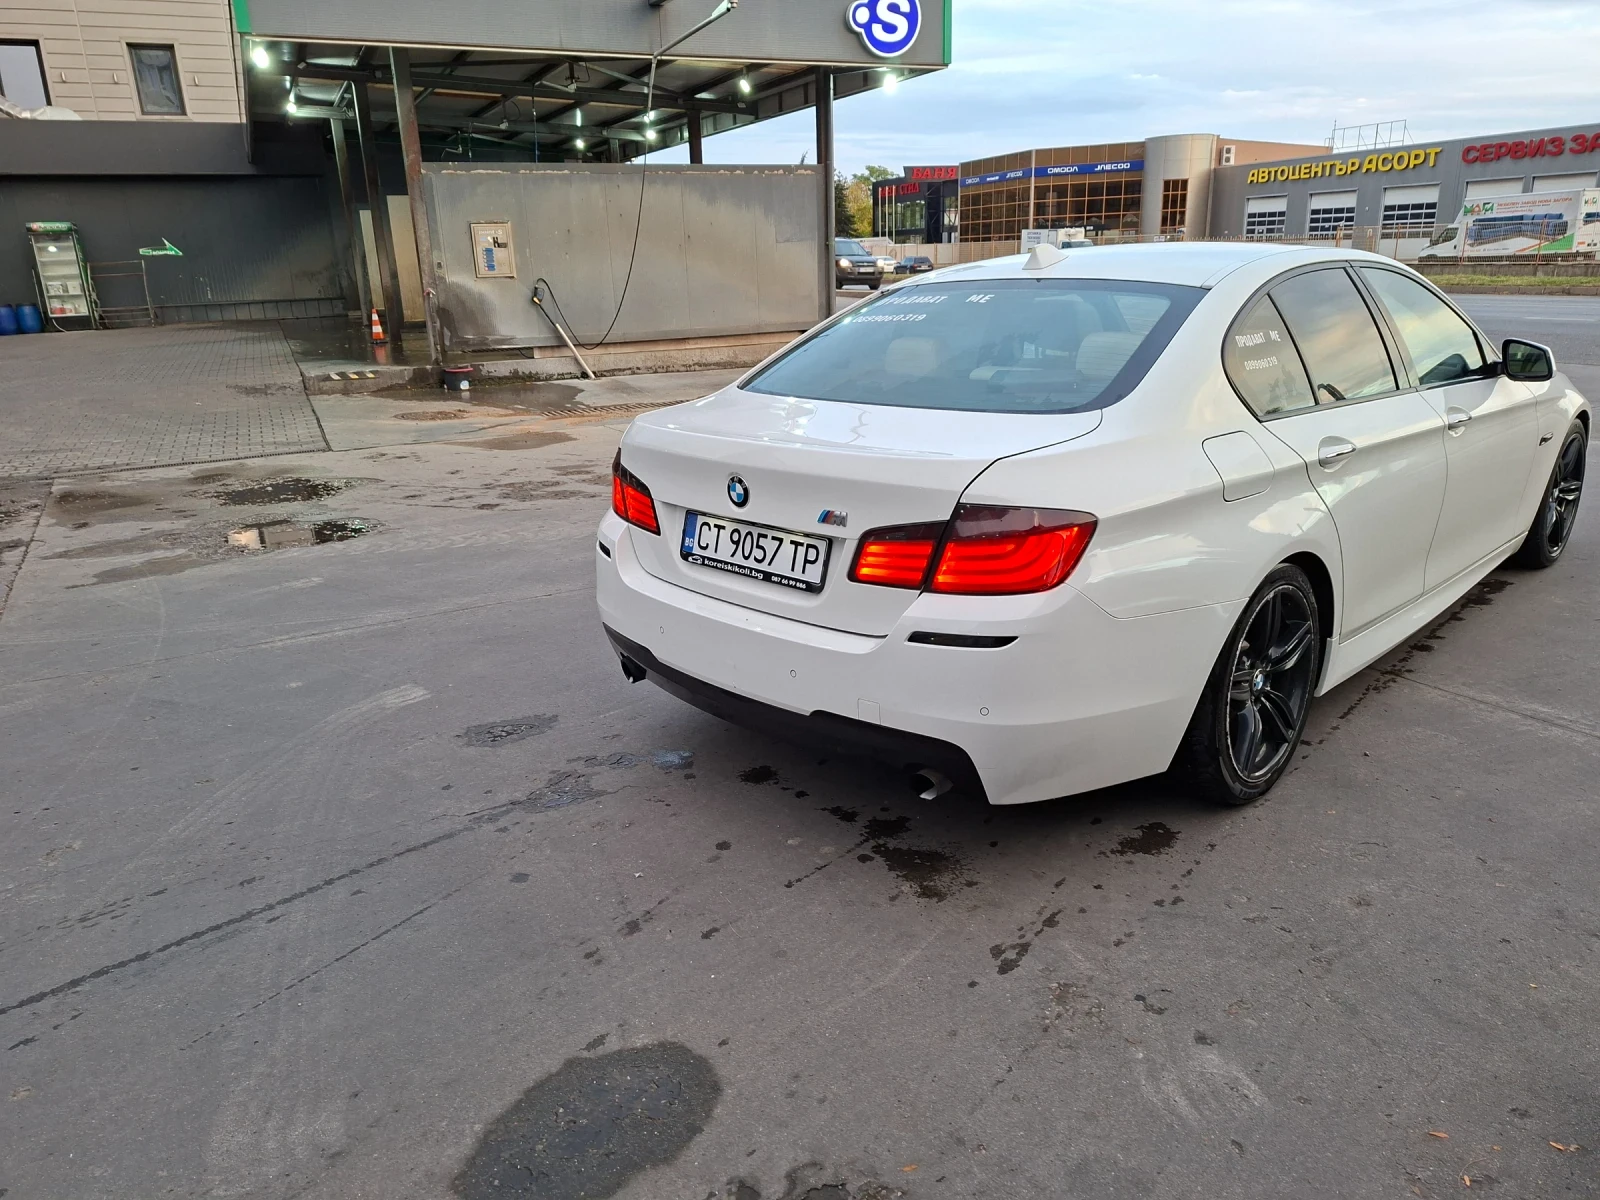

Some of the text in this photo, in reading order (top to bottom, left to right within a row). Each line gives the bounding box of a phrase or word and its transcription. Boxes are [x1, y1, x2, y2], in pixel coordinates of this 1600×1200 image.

[1461, 136, 1565, 164] СЕРВИЗ
[911, 167, 957, 179] БАНЯ
[1047, 166, 1079, 174] OMODA
[1094, 162, 1131, 171] JAECOO
[1247, 147, 1443, 184] АВТОЦЕНТЪР АСОРТ
[1235, 332, 1266, 348] ПРОДАВАТ
[685, 537, 694, 547] BG
[729, 528, 784, 567] 9057
[704, 558, 764, 580] koreiskikoli.bg
